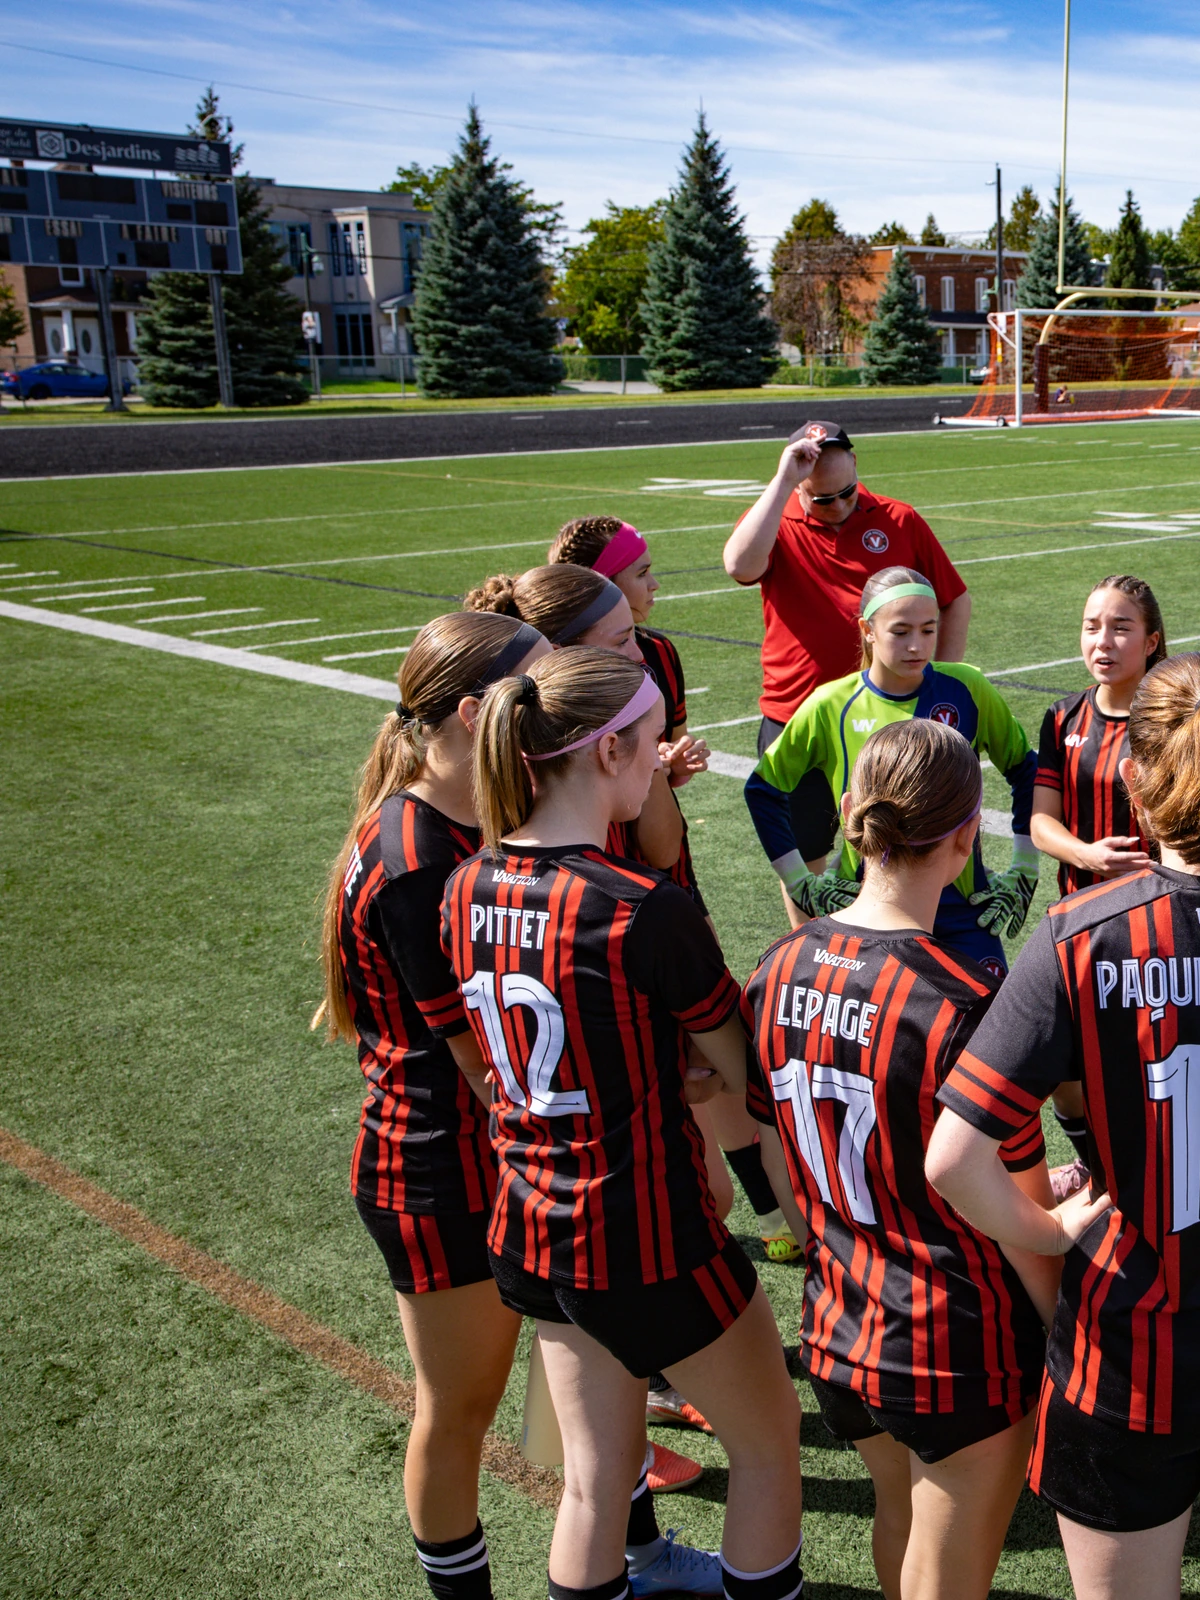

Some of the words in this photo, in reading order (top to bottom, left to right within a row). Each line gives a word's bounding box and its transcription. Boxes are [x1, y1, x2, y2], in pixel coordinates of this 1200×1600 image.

[66, 137, 161, 161] Desjardins
[161, 181, 219, 201] VISITEURS
[44, 219, 83, 237] ESSAI
[136, 224, 178, 243] FAIRE
[869, 536, 881, 548] V
[938, 712, 951, 725] V
[492, 869, 540, 886] VNATION
[470, 903, 550, 950] PITTET
[813, 948, 867, 972] VNATION
[776, 982, 879, 1048] LEPAGE
[461, 970, 592, 1117] 12
[770, 1058, 878, 1226] 17
